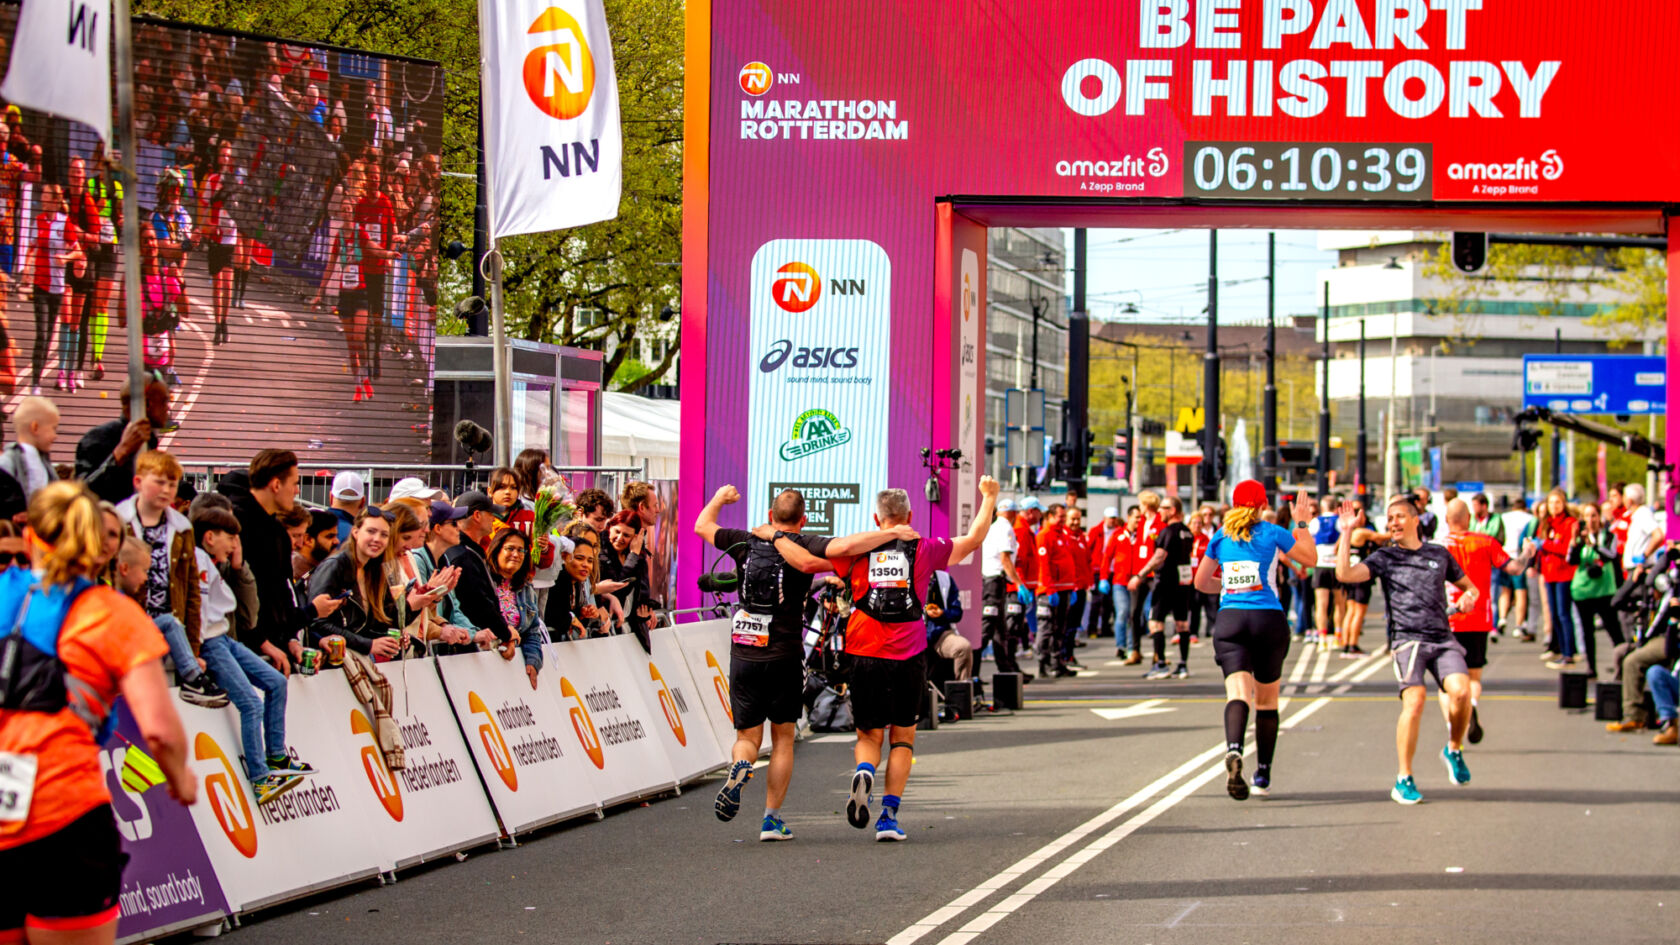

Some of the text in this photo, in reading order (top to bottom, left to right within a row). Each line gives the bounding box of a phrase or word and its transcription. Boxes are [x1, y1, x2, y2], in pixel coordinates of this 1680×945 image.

[1139, 0, 1483, 50] BE PART
[777, 72, 800, 85] NN
[1061, 58, 1562, 119] OF HISTORY
[740, 99, 897, 120] MARATHON
[740, 120, 909, 140] ROTTERDAM
[540, 138, 600, 180] NN
[1055, 154, 1145, 177] amazfit
[1193, 146, 1427, 192] 06:10:39
[1447, 157, 1539, 180] amazfit
[1080, 182, 1145, 192] A Zepp Brand
[1508, 184, 1539, 194] Brand
[830, 278, 865, 296] NN
[792, 346, 859, 369] asics
[806, 420, 832, 441] AA
[801, 434, 839, 453] DRINK
[773, 487, 855, 499] RTERDAM.
[814, 500, 827, 511] IT
[870, 567, 904, 577] 13501
[1227, 575, 1256, 585] 25587
[735, 620, 763, 632] 27757
[584, 683, 621, 714] nationale
[496, 697, 536, 731] nationale
[599, 714, 646, 747] nederlanden
[512, 731, 563, 767] nederlanden
[400, 751, 462, 793] nederlanden
[146, 873, 179, 910] sound
[172, 868, 205, 906] body
